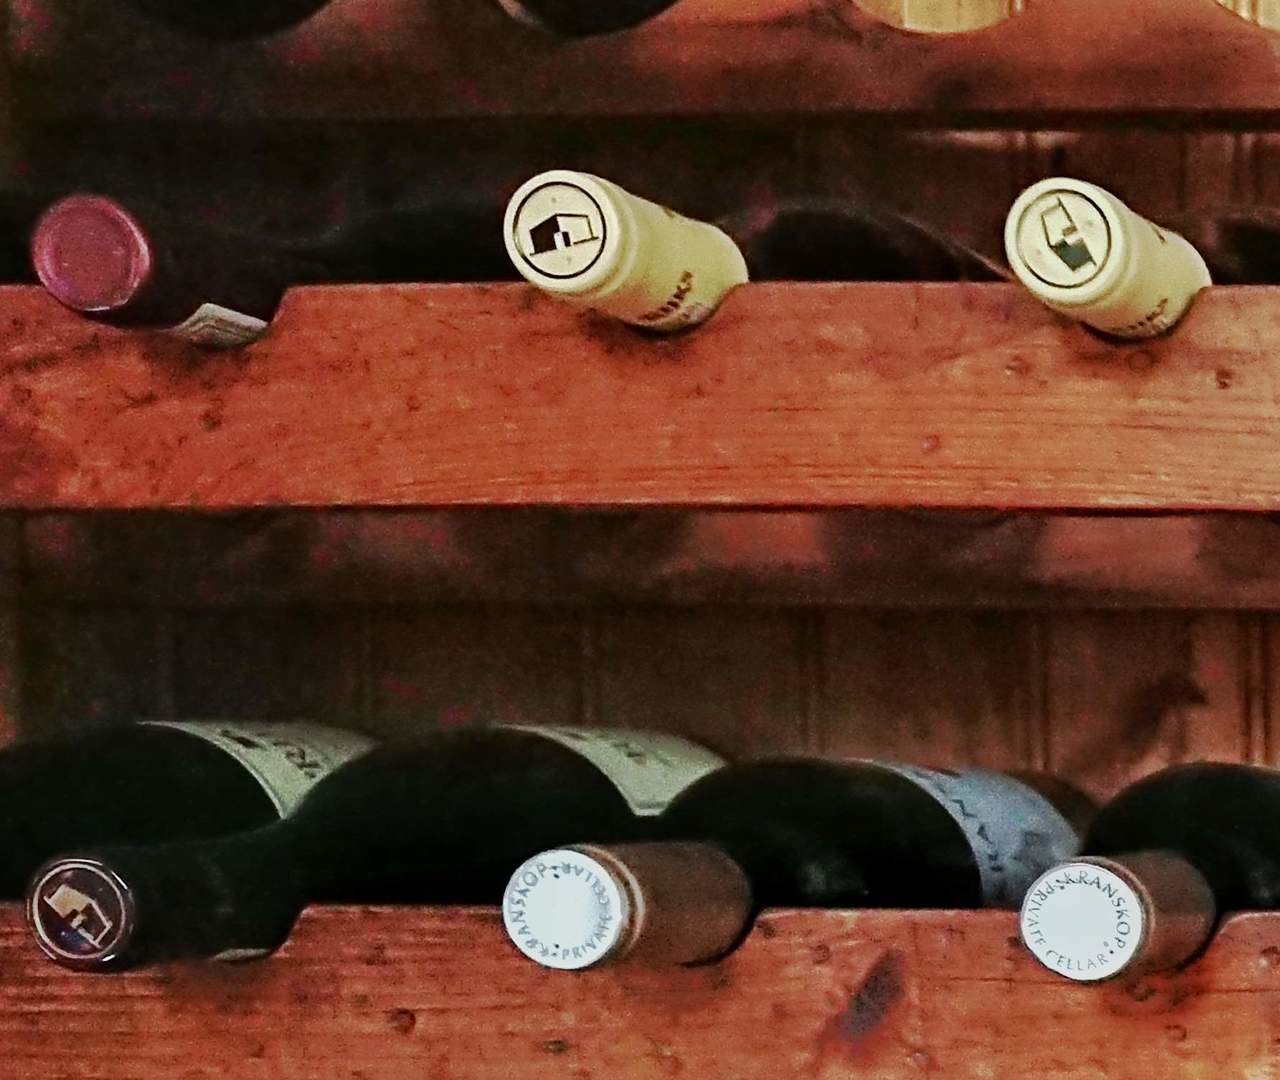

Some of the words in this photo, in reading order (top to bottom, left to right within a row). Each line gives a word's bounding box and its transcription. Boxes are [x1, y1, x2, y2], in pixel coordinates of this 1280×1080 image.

[510, 861, 550, 958] KRANSKOP
[1063, 870, 1131, 949] KRANSKOP
[1046, 949, 1110, 972] CELLAR
